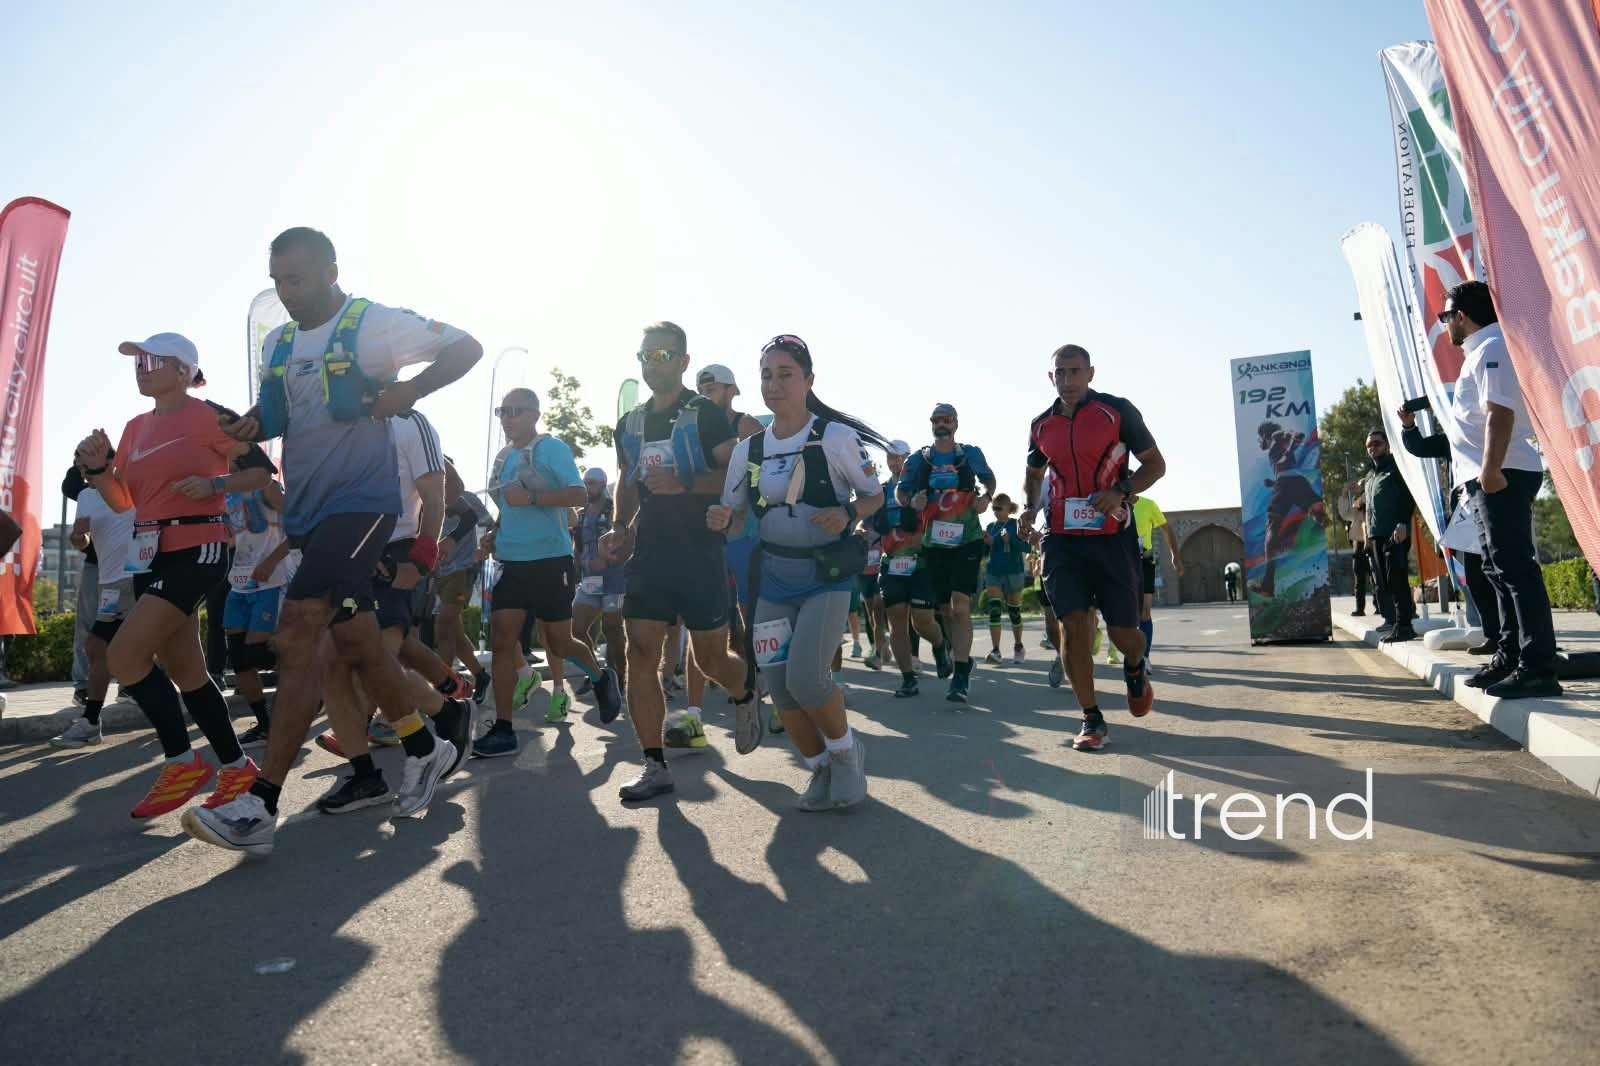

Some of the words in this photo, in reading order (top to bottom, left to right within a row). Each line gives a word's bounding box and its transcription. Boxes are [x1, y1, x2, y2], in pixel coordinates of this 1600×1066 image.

[9, 253, 38, 354] circuit
[4, 357, 27, 419] city
[1239, 385, 1287, 405] 192
[1265, 399, 1311, 419] KM
[0, 424, 18, 513] Baku
[1073, 508, 1096, 520] 053
[755, 637, 779, 655] 070
